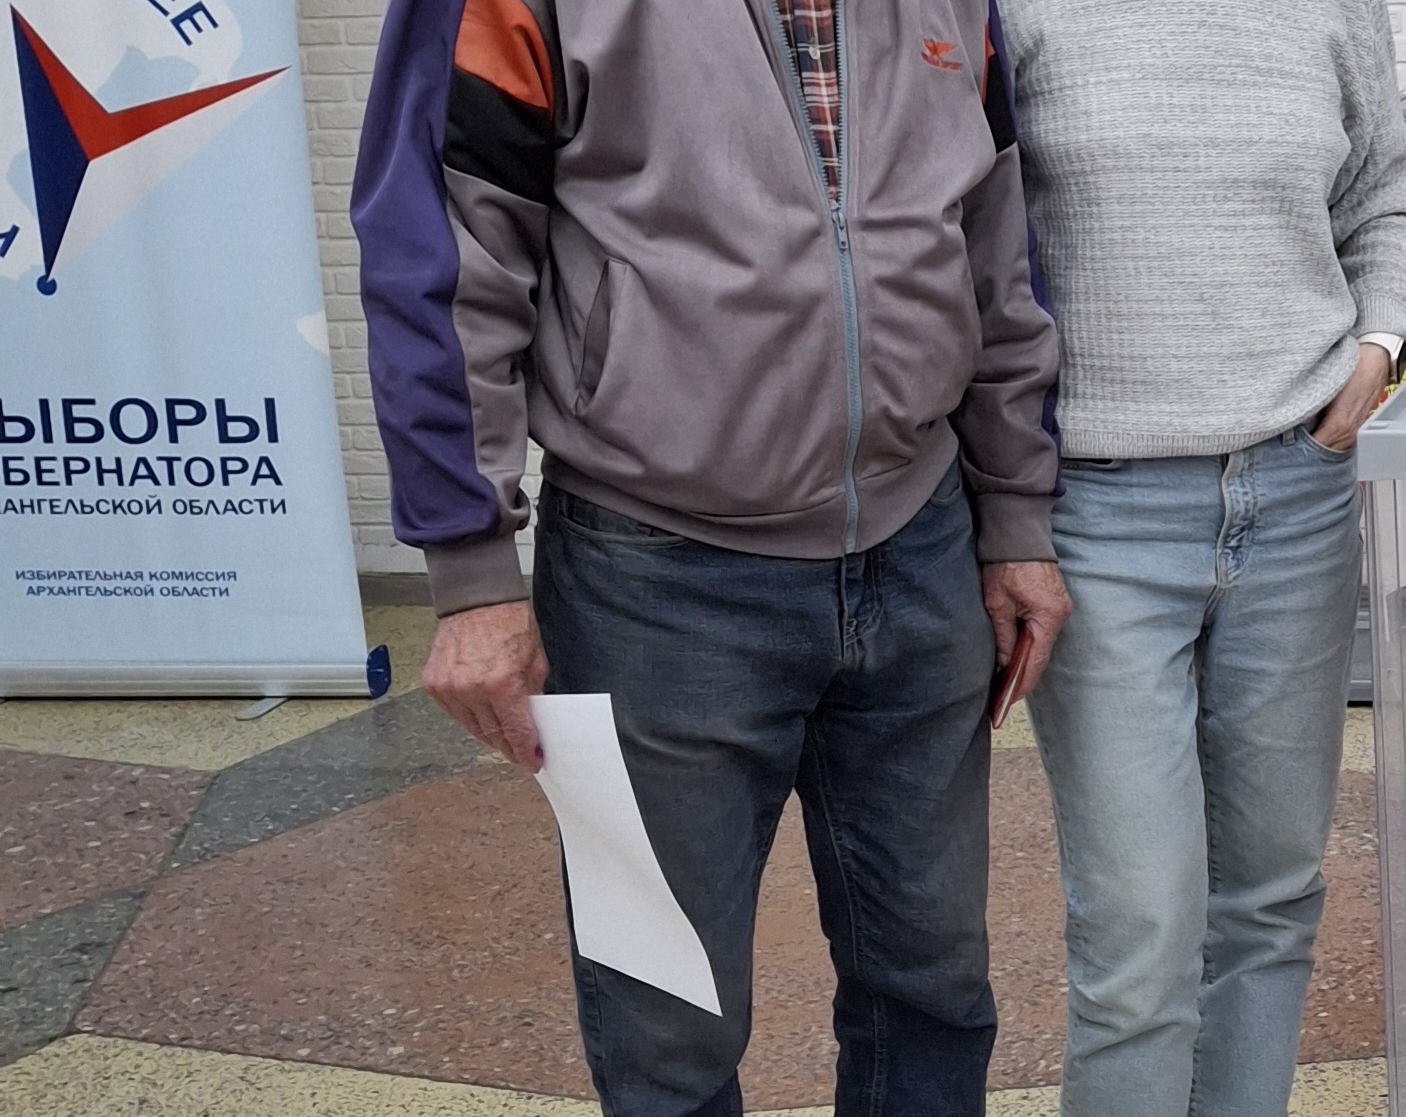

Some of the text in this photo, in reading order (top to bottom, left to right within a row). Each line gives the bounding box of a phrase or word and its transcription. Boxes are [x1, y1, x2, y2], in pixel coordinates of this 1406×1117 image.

[0, 397, 280, 445] ЫБОРЫ
[1, 456, 284, 487] БЕРНАТОРА
[0, 494, 287, 516] АНГЕЛЬСКОЙ ОБЛАСТИ
[15, 570, 238, 582] ИЗБИРАТЕЛЬНАЯ КОМИССИЯ
[26, 584, 230, 598] АРХАНГЕЛЬСКОЙ ОБЛАСТИ
